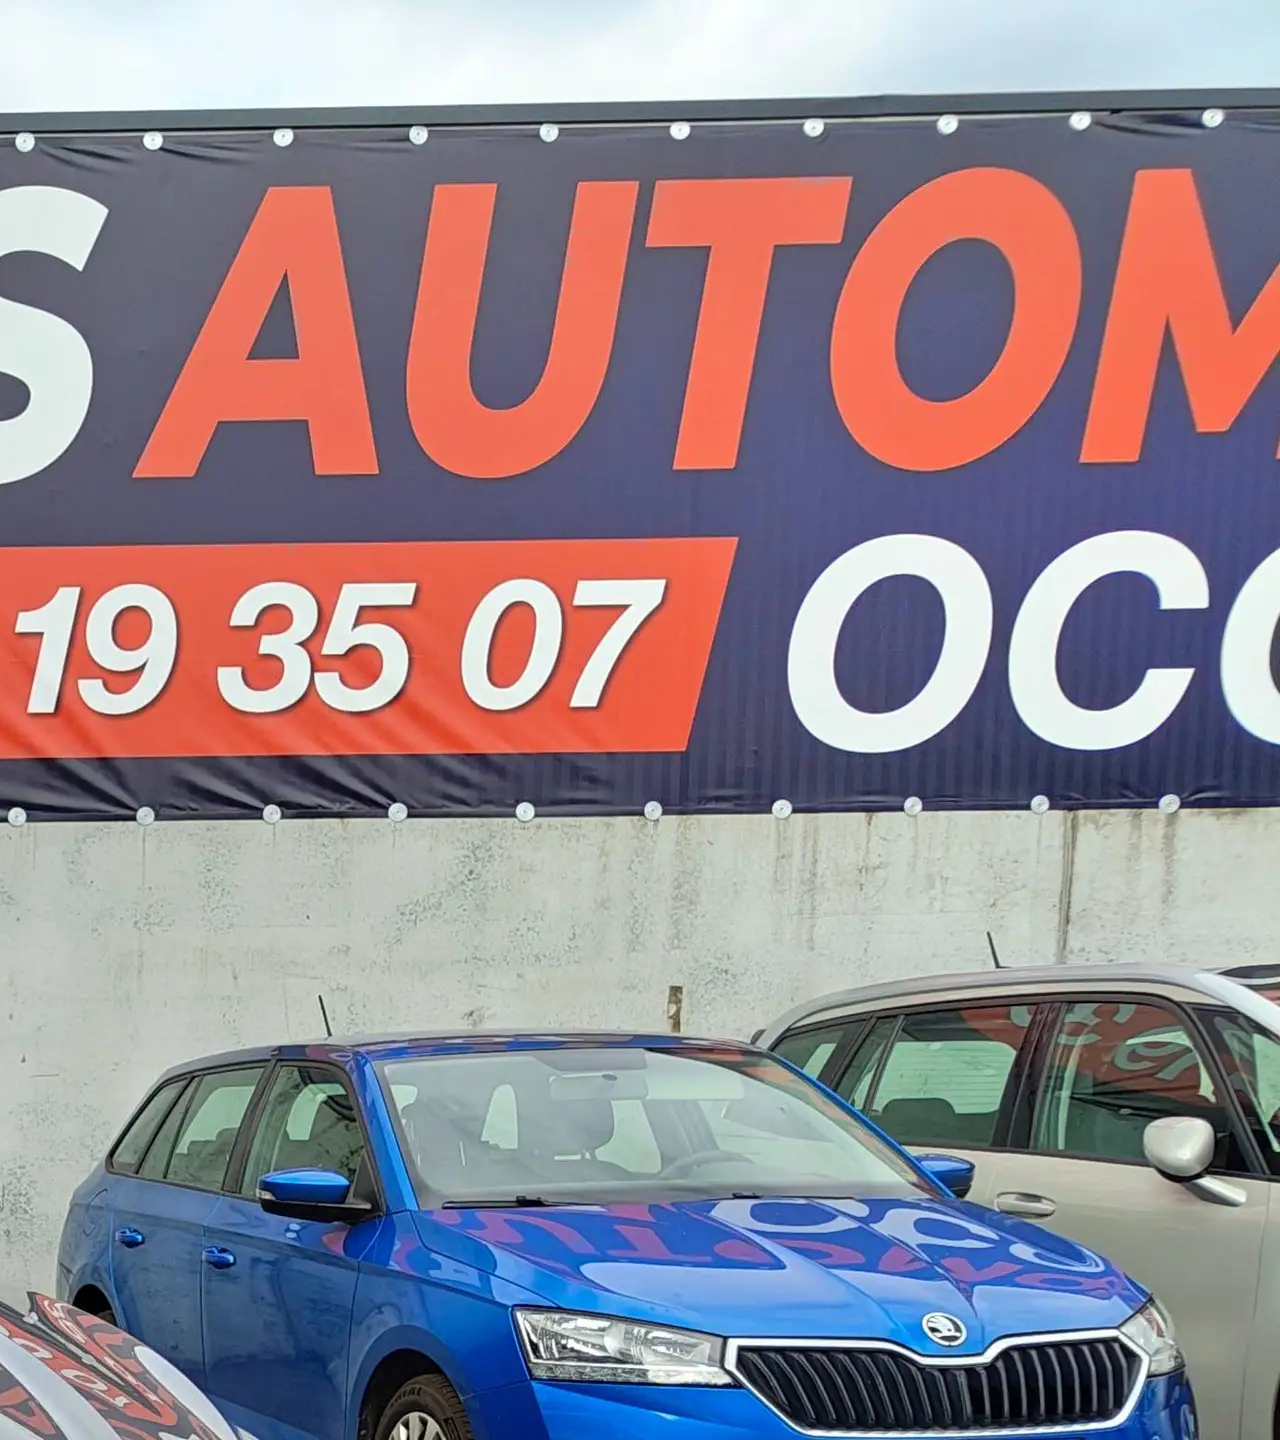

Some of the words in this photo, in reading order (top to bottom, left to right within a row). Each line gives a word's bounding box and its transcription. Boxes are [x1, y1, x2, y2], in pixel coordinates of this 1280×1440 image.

[14, 583, 177, 715] 19
[217, 581, 417, 713] 35
[461, 578, 668, 711] 07
[787, 529, 1280, 754] OC
